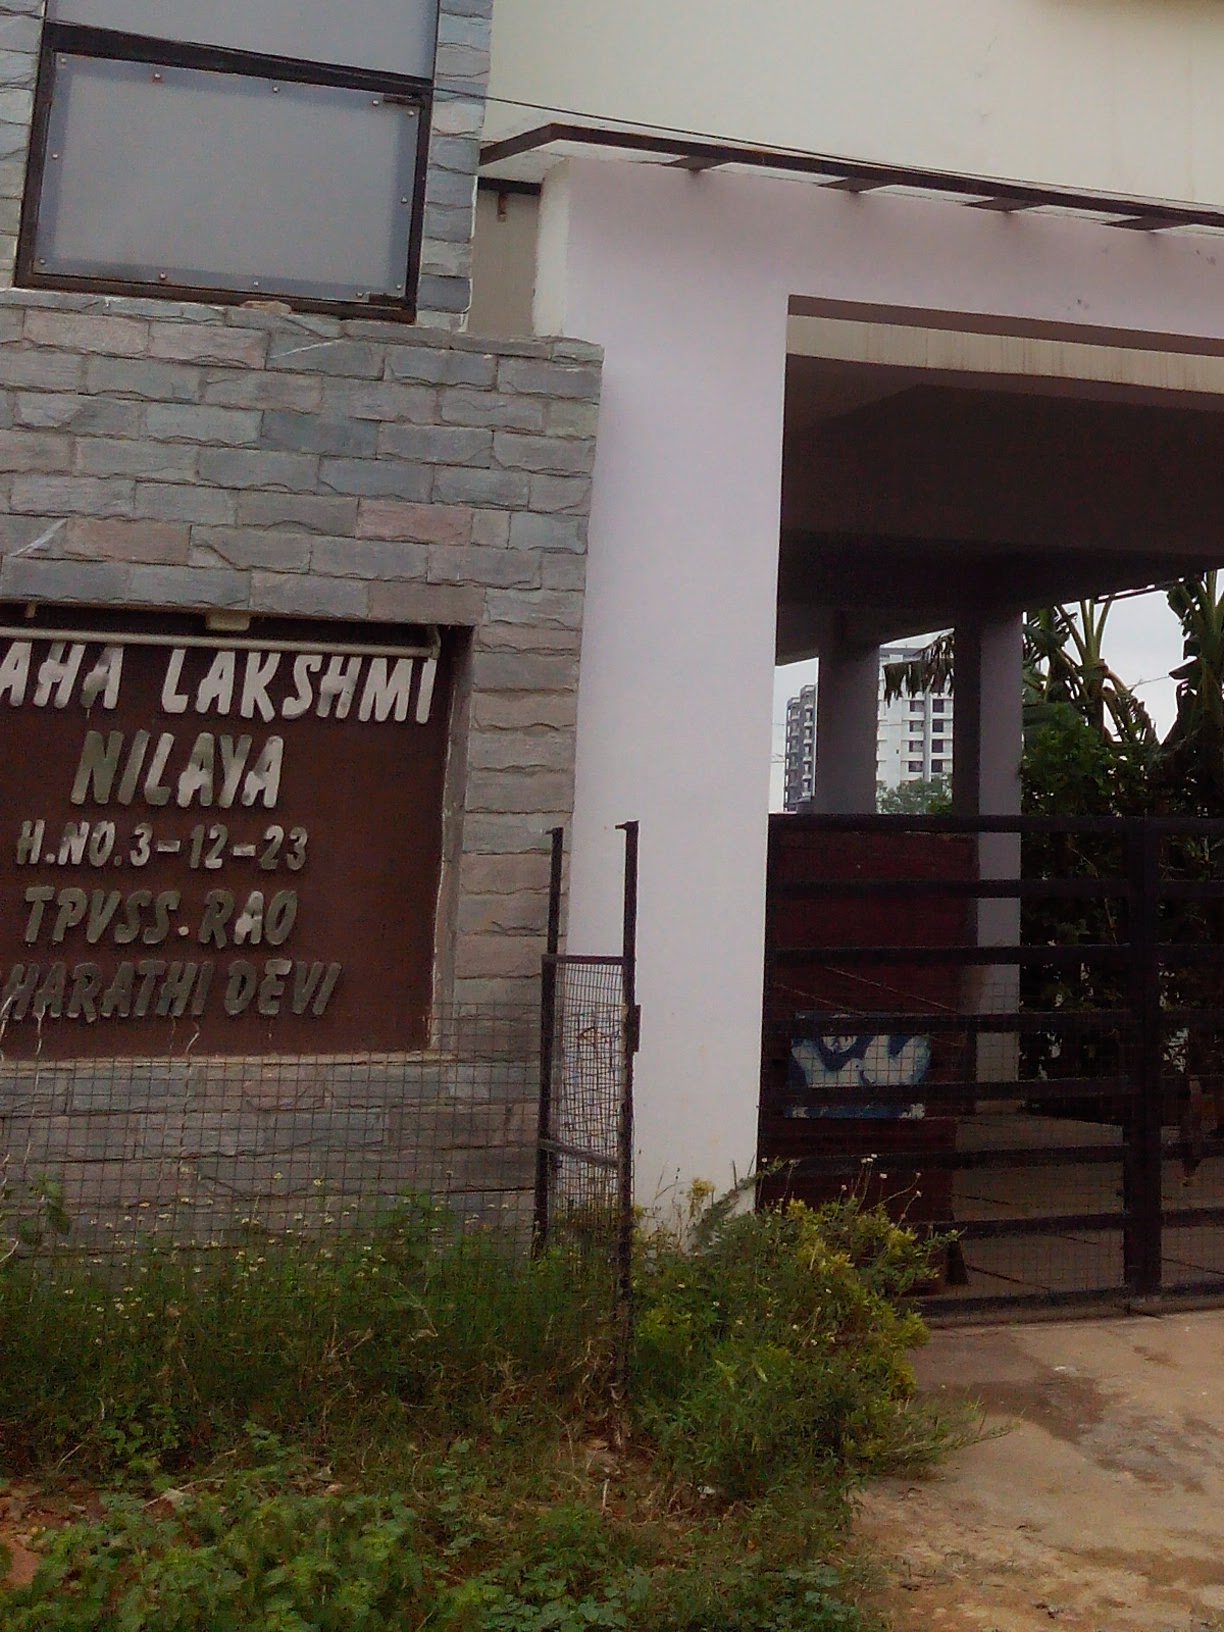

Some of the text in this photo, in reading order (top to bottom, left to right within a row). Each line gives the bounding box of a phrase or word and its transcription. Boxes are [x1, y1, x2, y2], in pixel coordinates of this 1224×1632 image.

[161, 649, 438, 724] LAKSHMI
[70, 729, 284, 808] NILAYA
[223, 958, 342, 1016] DEVI
